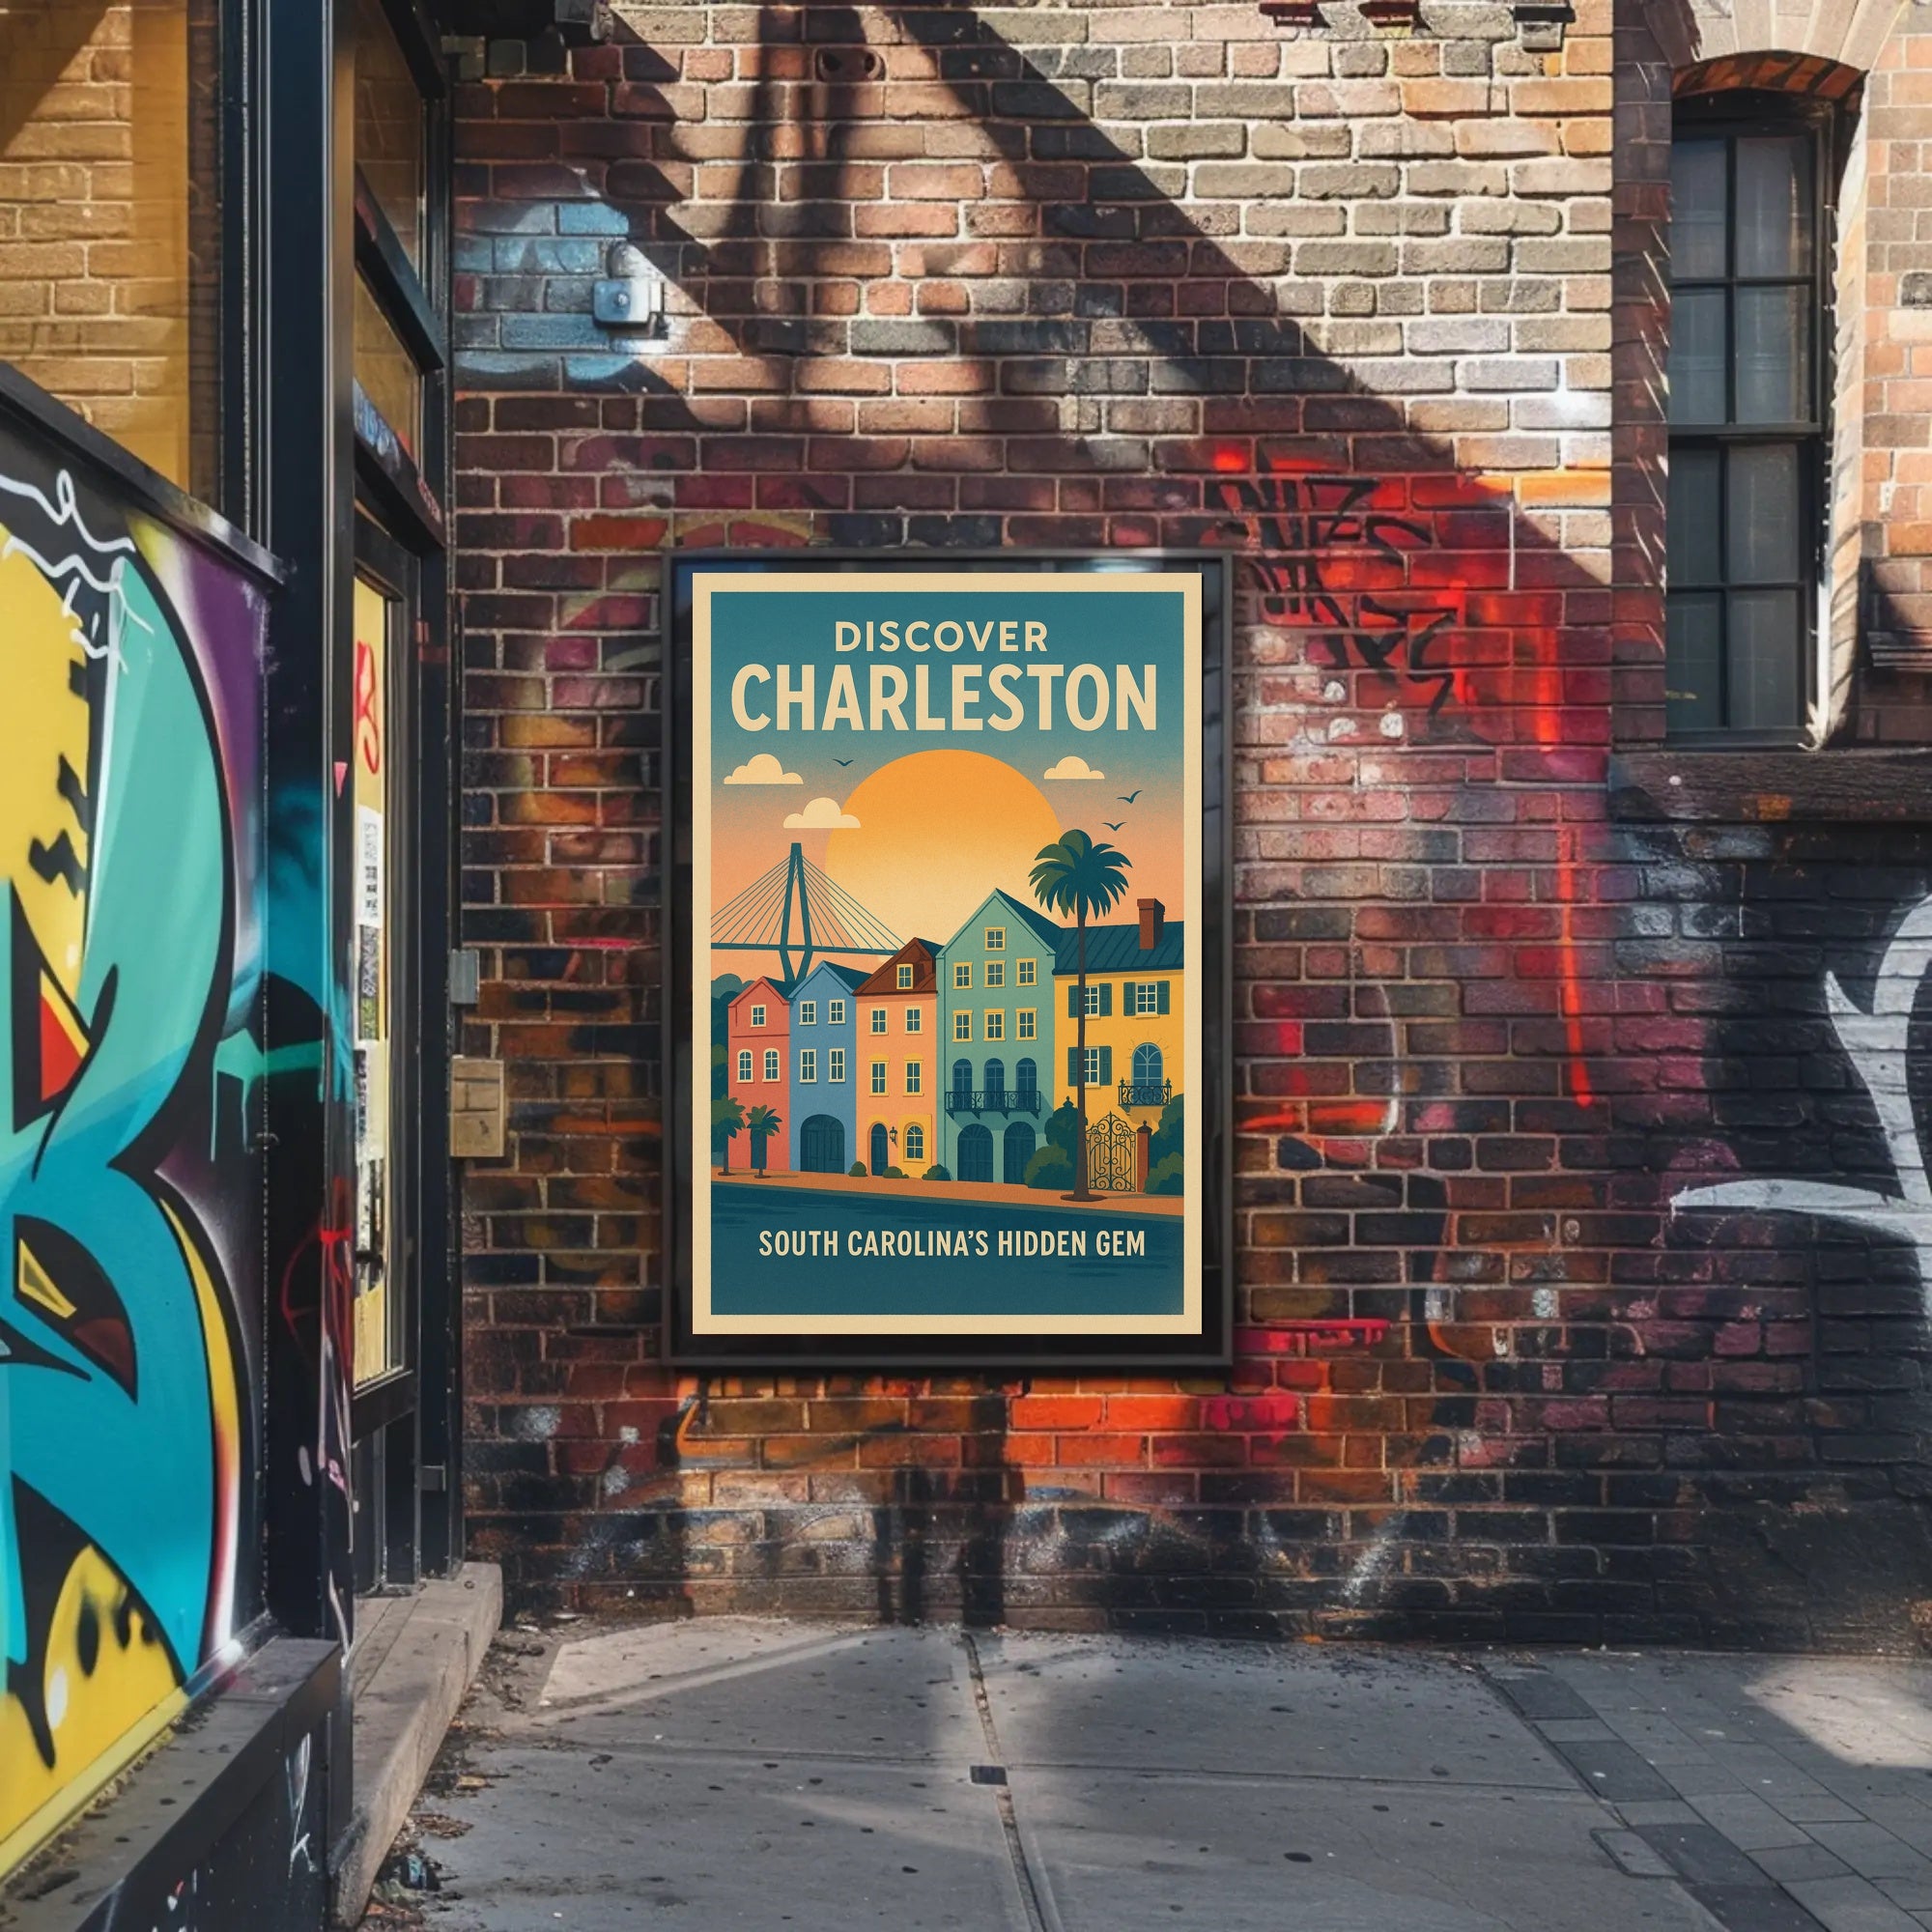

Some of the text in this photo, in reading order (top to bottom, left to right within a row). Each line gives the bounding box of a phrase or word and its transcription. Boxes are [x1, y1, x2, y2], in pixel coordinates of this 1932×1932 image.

[835, 620, 1048, 652] DISCOVER
[730, 663, 1157, 732] CHARLESTON
[758, 1230, 1146, 1257] SOUTH CAROLINA’S HIDDEN GEM
